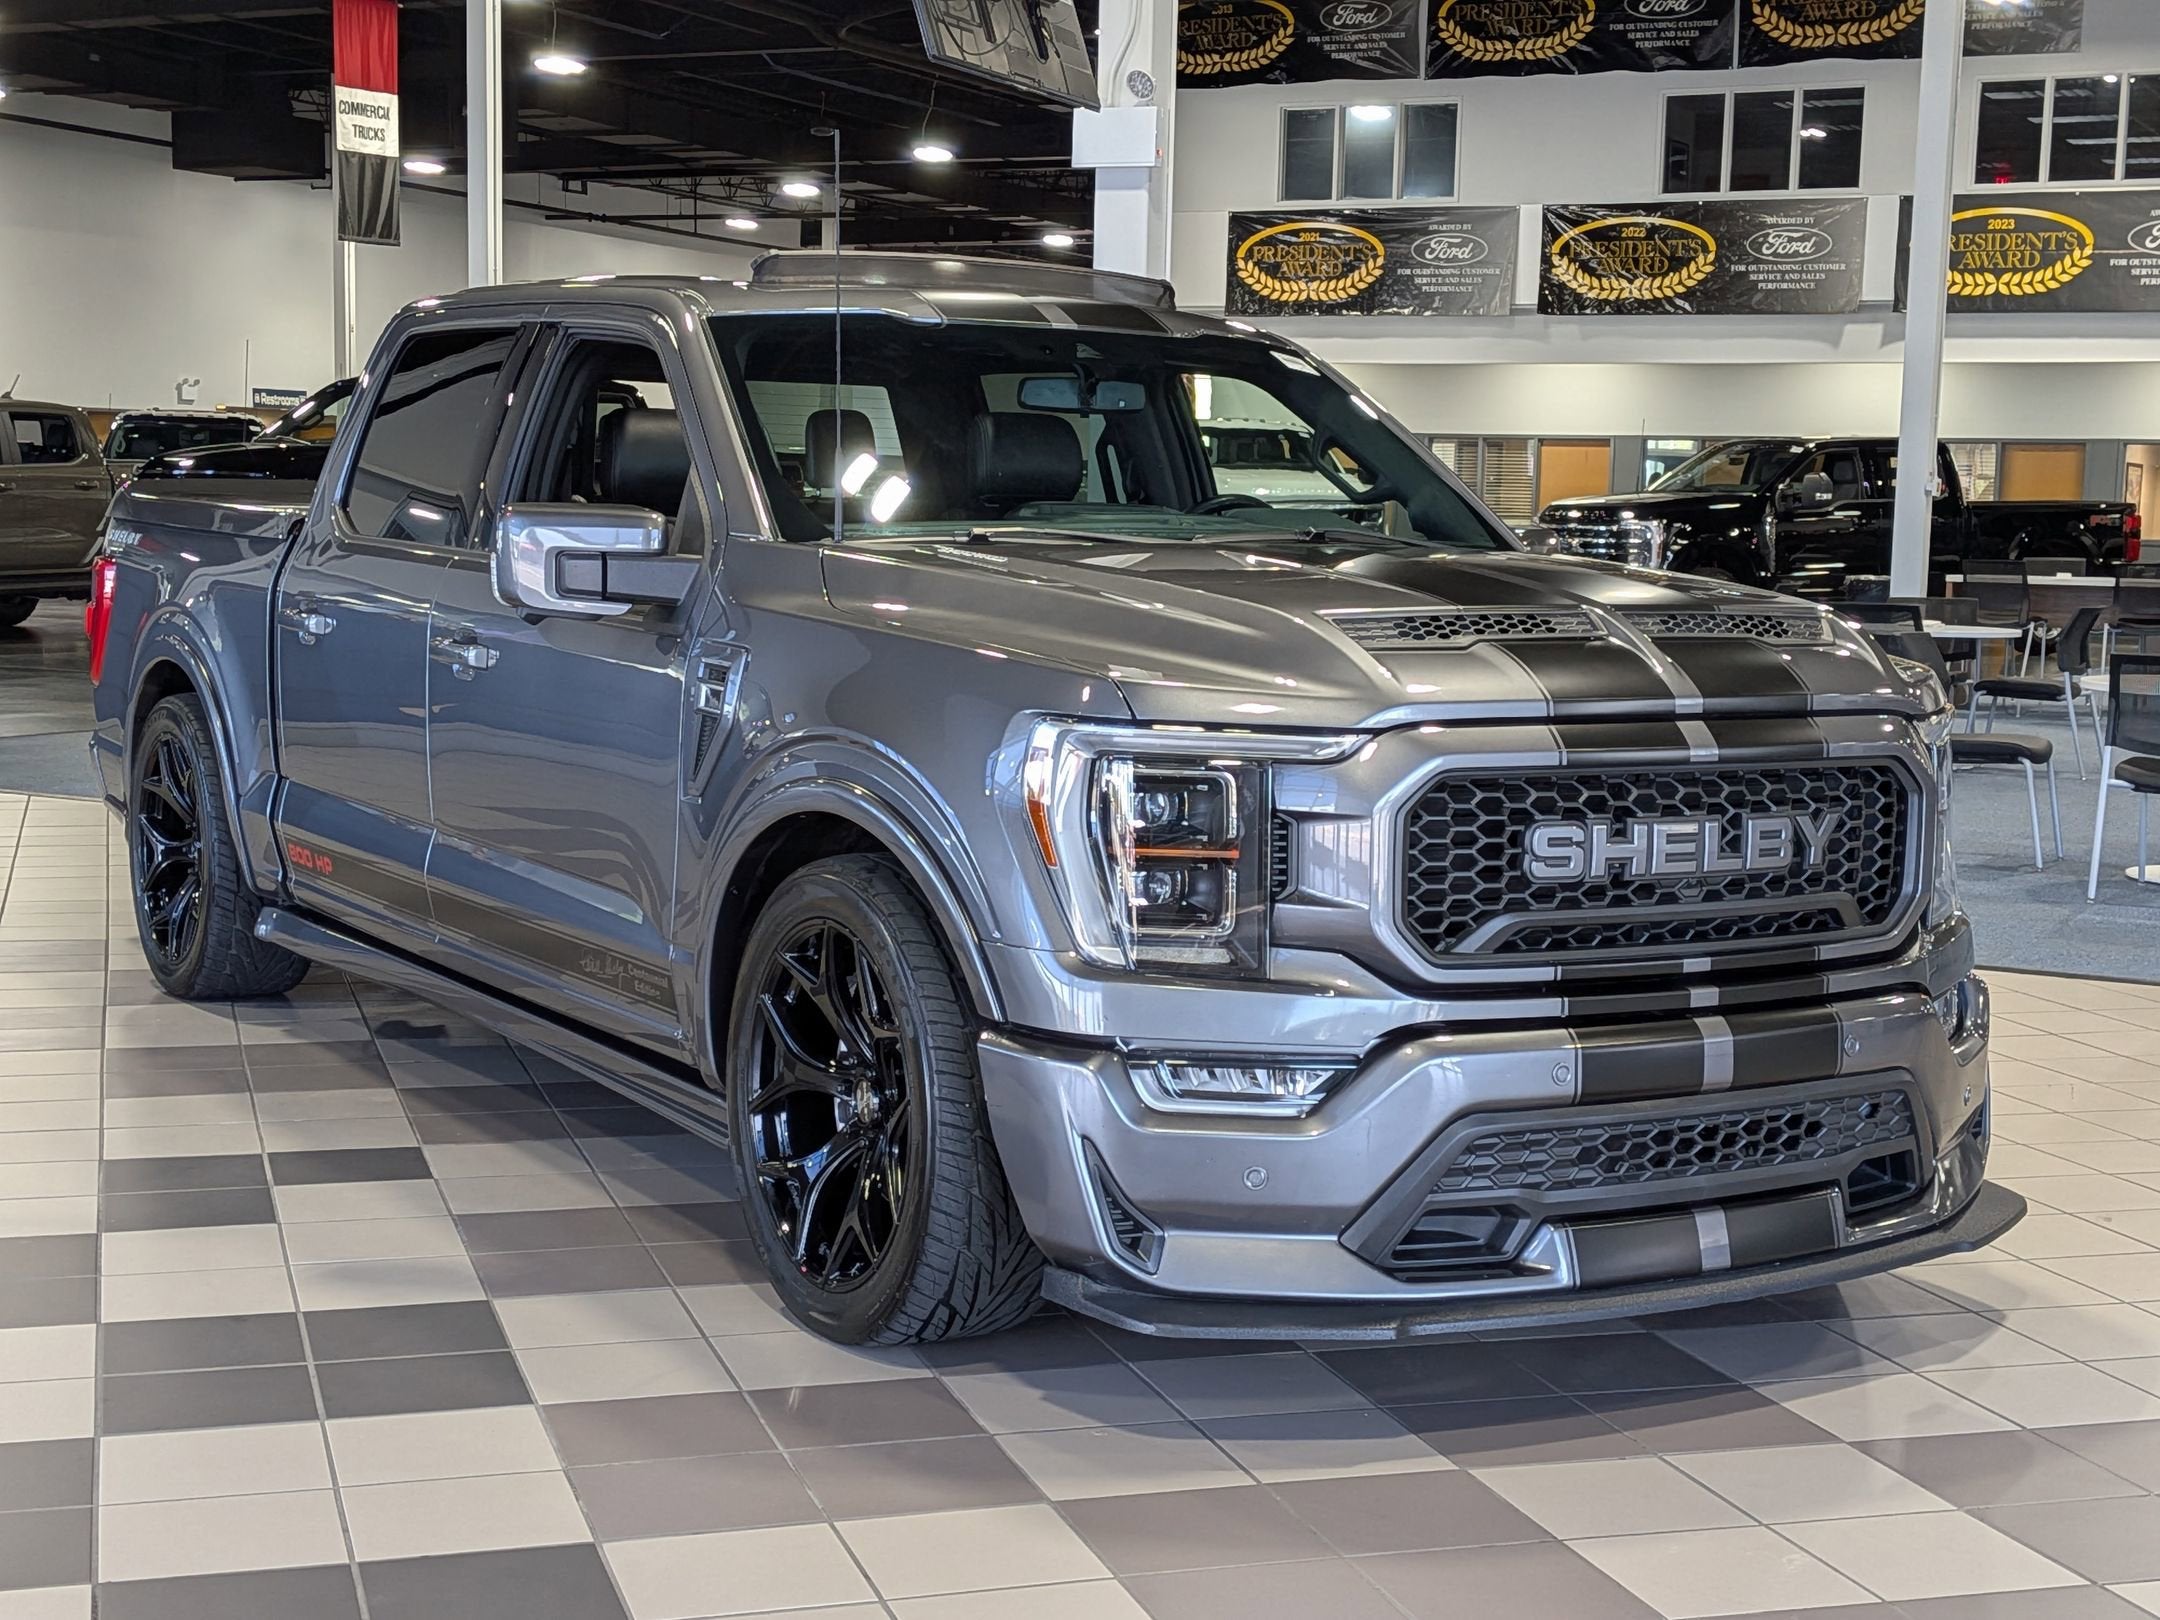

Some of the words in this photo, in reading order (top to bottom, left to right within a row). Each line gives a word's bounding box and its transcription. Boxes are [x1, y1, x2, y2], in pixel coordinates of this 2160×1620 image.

[1332, 4, 1378, 26] Ford
[1800, 0, 1877, 21] AWARD
[1178, 13, 1283, 36] RESIDENT'S
[1481, 18, 1551, 37] AWARD
[1609, 23, 1624, 31] FOR
[1625, 21, 1677, 30] OUTSTANDING
[1678, 20, 1719, 28] CUSTOMER
[1192, 31, 1254, 50] AWARD
[1368, 32, 1406, 40] CUSTOMER
[1627, 32, 1657, 40] SERVICE
[1635, 39, 1691, 48] PERFORMANCE
[352, 124, 386, 142] TRUCKS
[1621, 227, 1647, 237] 2022
[1987, 219, 2015, 229] 2023
[1299, 232, 1321, 242] 2021
[1761, 231, 1816, 255] Ford
[1950, 230, 2078, 252] RESIDENT'S
[1252, 242, 1373, 263] PRESIDENT'S
[1425, 237, 1474, 259] Ford
[1568, 238, 1702, 259] PRESIDENT'S
[1596, 257, 1669, 274] AWARD
[1730, 264, 1747, 272] FOR
[1747, 263, 1802, 271] OUTSTANDING
[1803, 263, 1847, 271] CUSTOMER
[1957, 250, 2041, 269] AWARD
[2109, 258, 2128, 266] FOR
[1277, 260, 1343, 278] AWARD
[1749, 273, 1782, 281] SERVICE
[1801, 272, 1826, 280] SALES
[1758, 282, 1816, 290] PERFORMANCE
[260, 392, 300, 406] Restrooms
[1528, 810, 1843, 882] SHELBY
[287, 843, 313, 868] 800
[314, 853, 333, 875] HP
